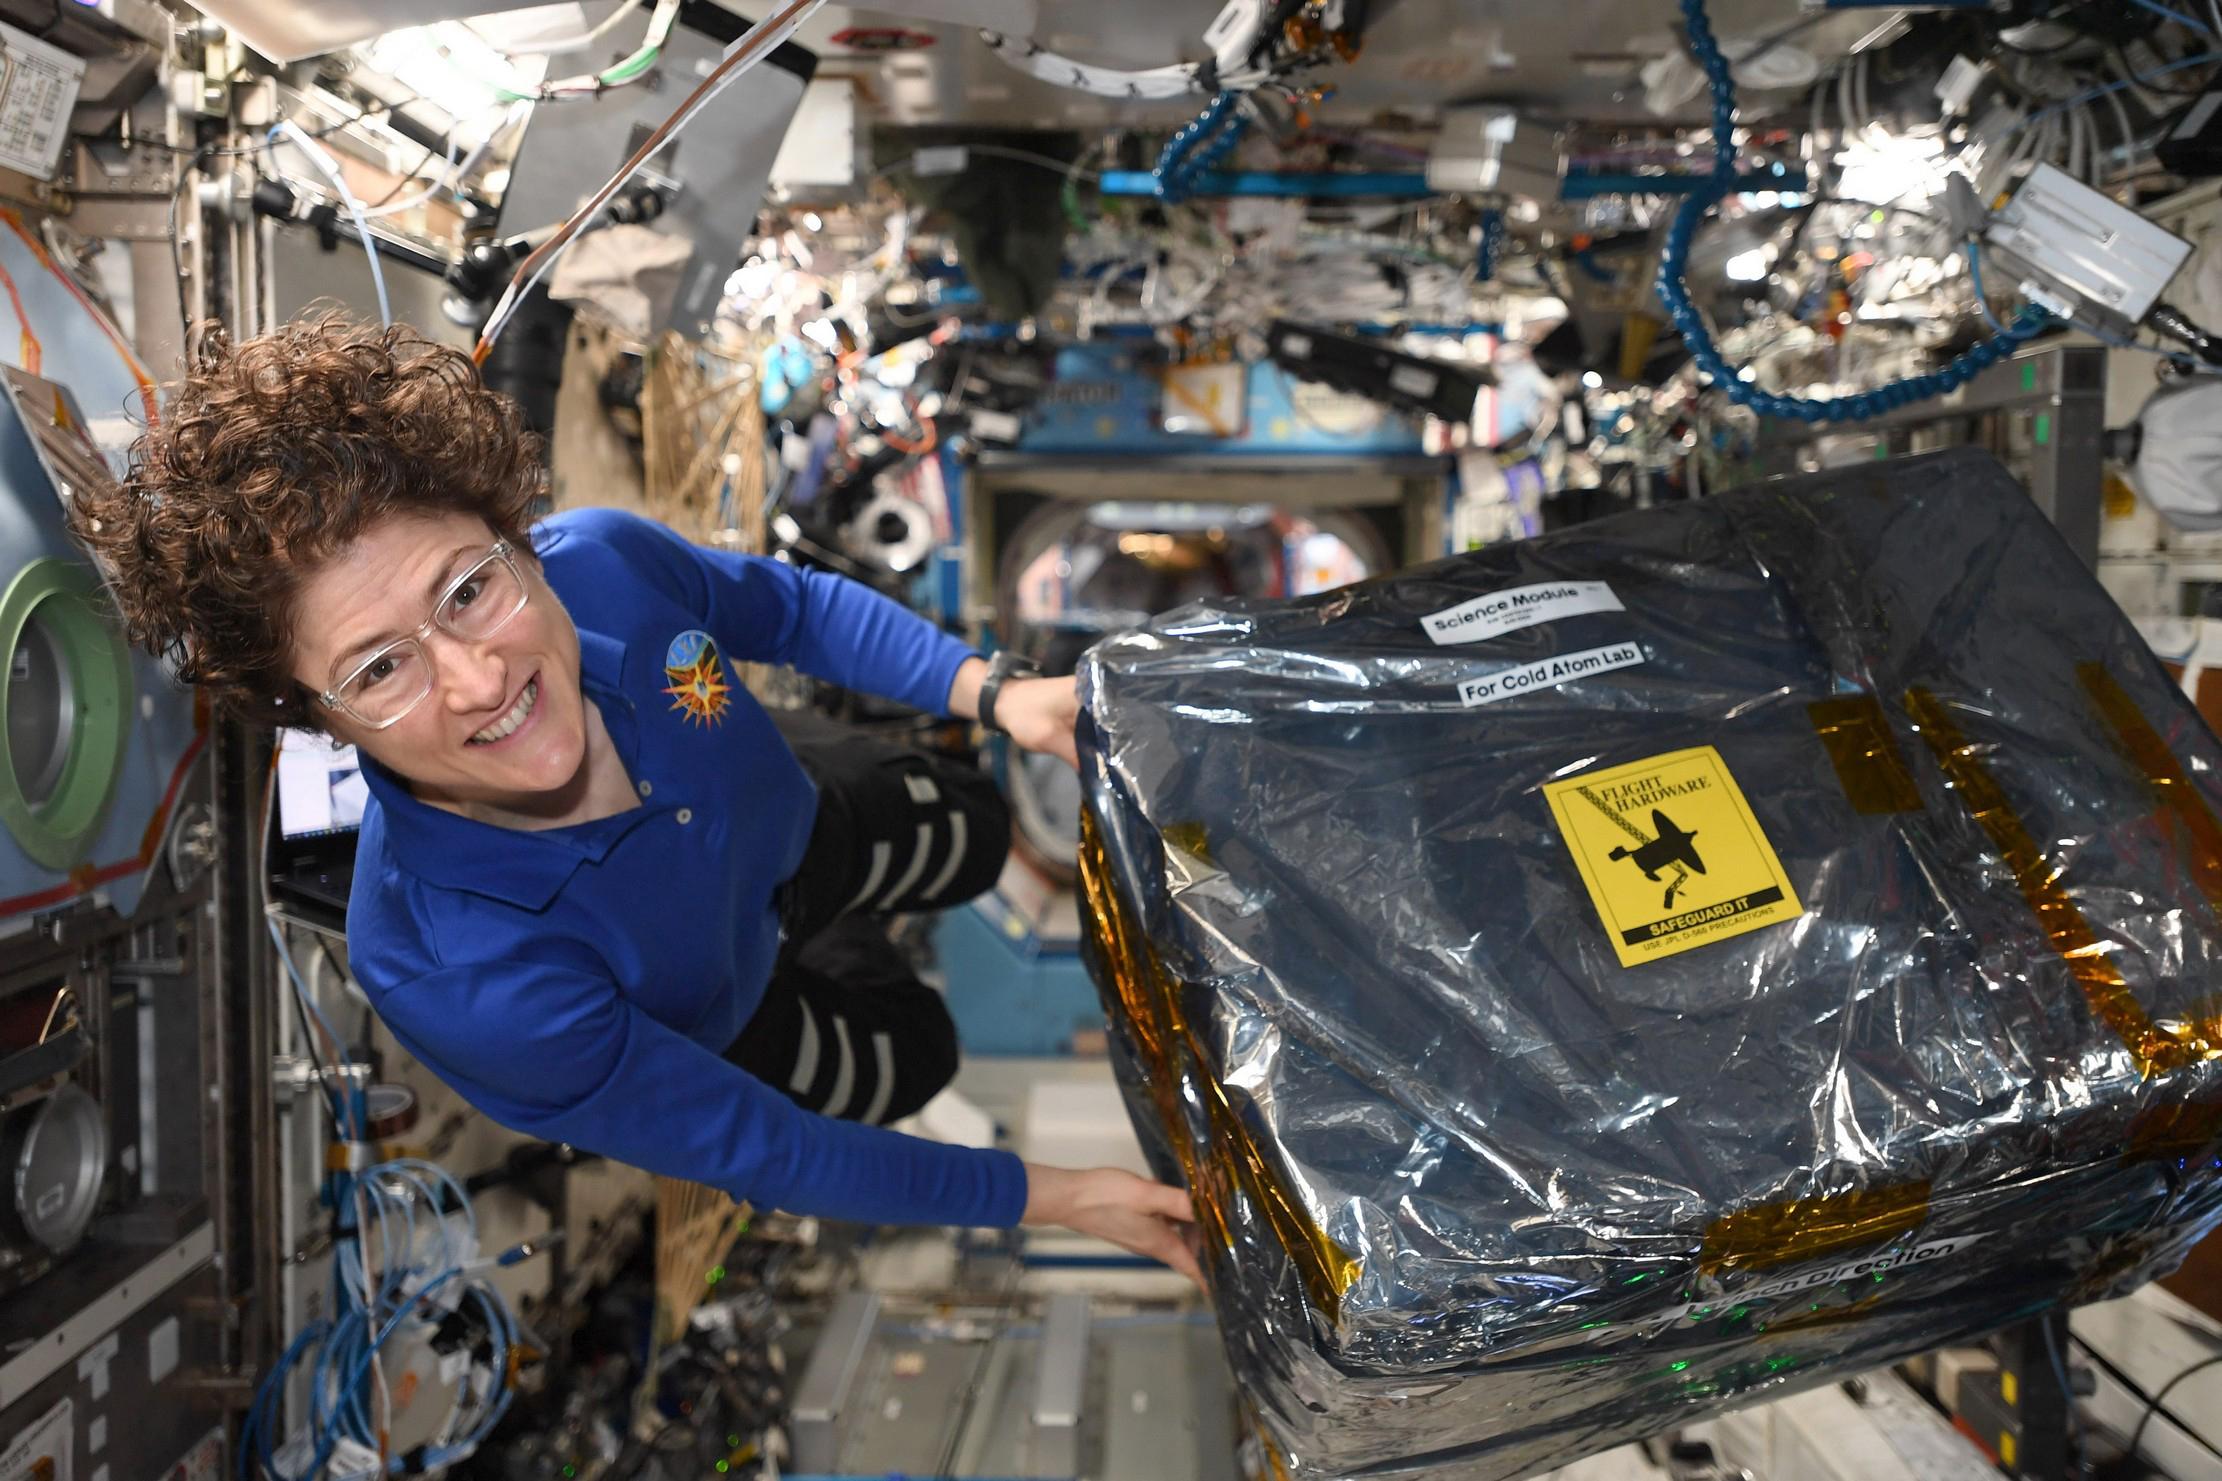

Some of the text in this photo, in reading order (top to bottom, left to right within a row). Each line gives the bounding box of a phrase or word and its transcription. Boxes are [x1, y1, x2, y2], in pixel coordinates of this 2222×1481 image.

[1434, 601, 1509, 631] Science
[1512, 587, 1579, 607] Module
[1466, 648, 1636, 700] For Cold Atom Lab
[1601, 776, 1662, 802] FLIGHT
[1615, 776, 1712, 813] HARDWARE
[1643, 939, 1662, 951] USE
[1709, 906, 1775, 931] PRECAUTIONS
[1650, 897, 1749, 936] SAFEGUARD IT
[1808, 1242, 1955, 1285] Direction
